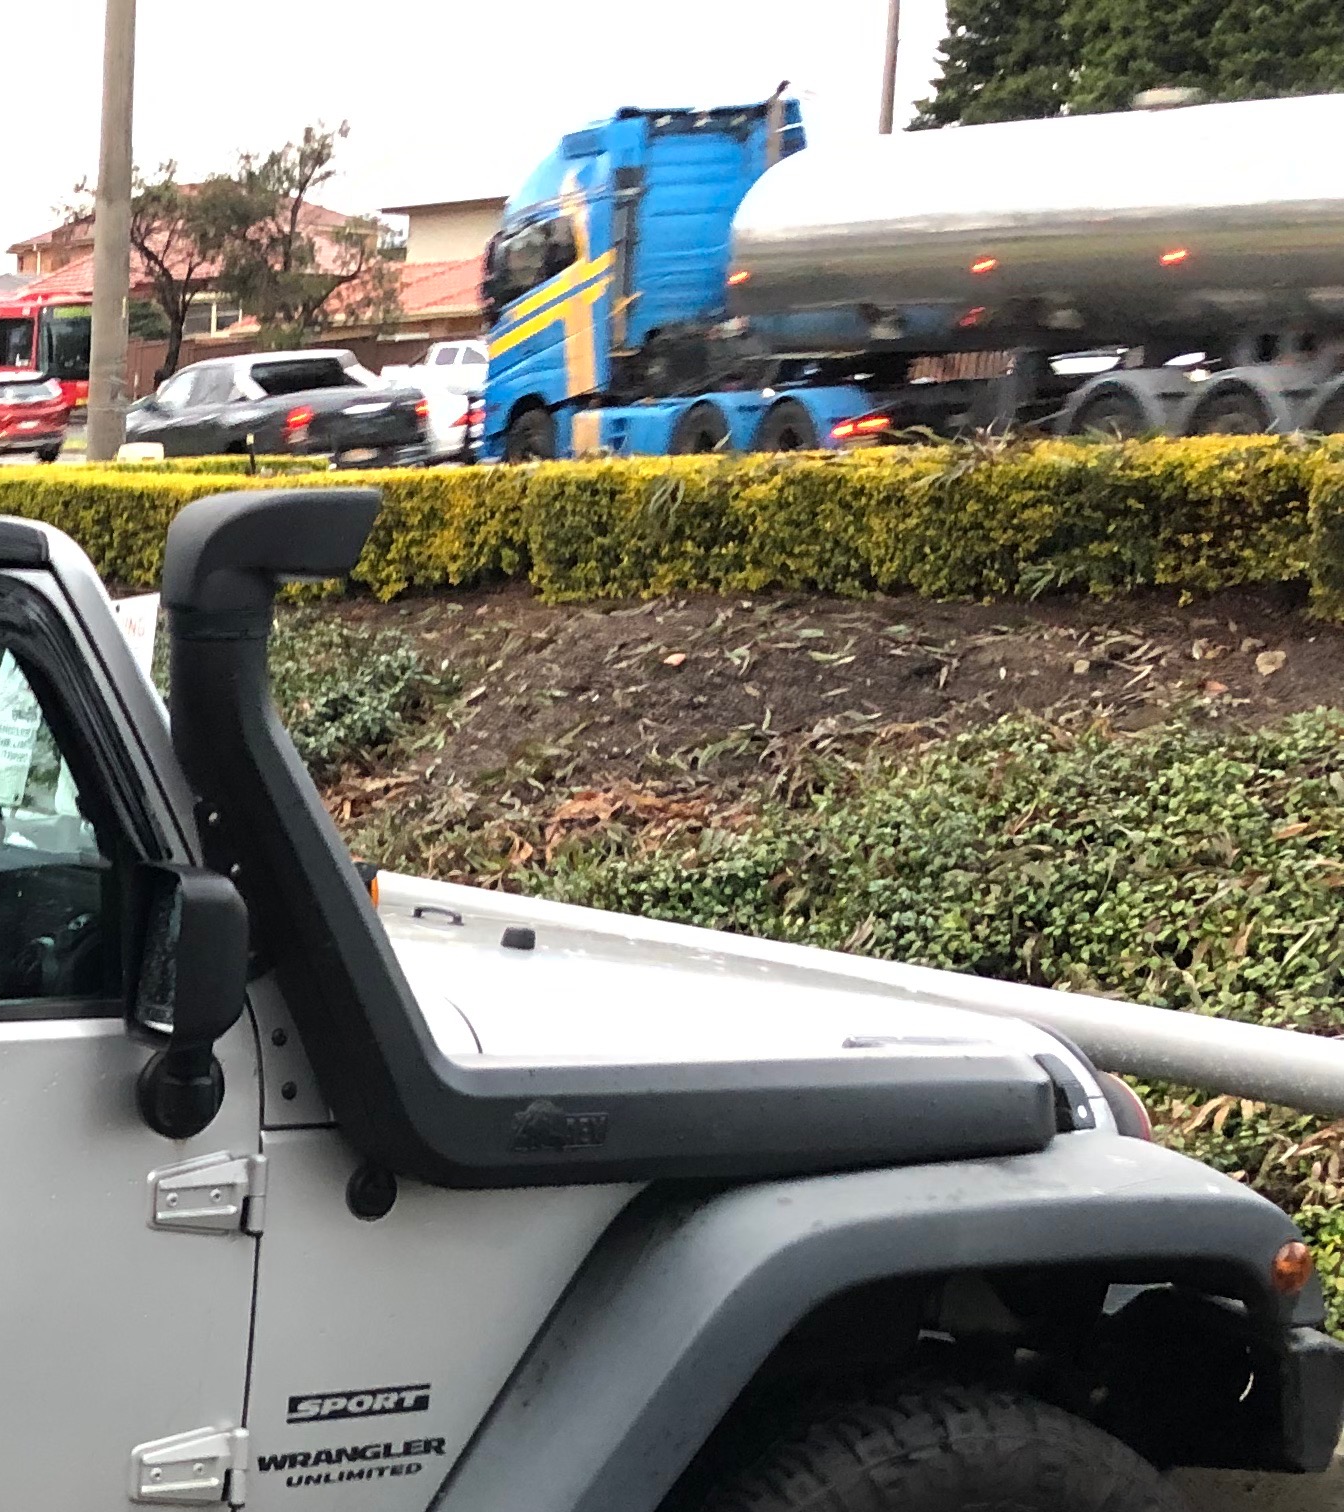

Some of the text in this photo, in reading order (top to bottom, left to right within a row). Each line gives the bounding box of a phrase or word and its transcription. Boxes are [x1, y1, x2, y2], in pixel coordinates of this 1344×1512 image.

[288, 1387, 431, 1421] SPORT
[257, 1437, 446, 1472] WRANGLER
[285, 1462, 423, 1488] UNLIMITED
